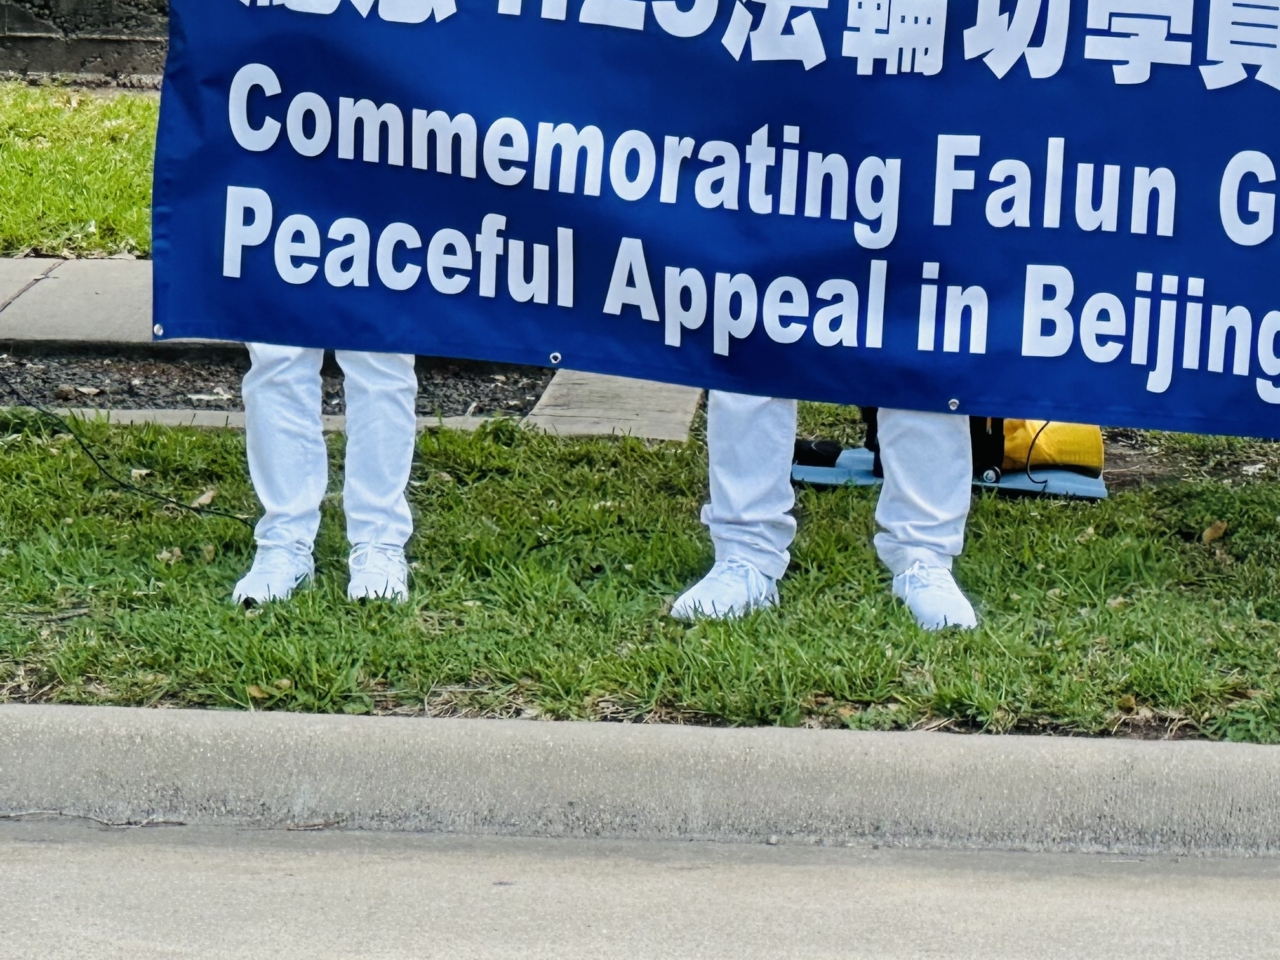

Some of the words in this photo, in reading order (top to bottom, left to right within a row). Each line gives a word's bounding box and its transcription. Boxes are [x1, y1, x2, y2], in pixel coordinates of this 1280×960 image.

[229, 64, 900, 248] Commemorating
[933, 134, 1176, 236] Falun
[223, 185, 574, 308] Peaceful
[602, 237, 887, 355] Appeal
[917, 262, 989, 354] in
